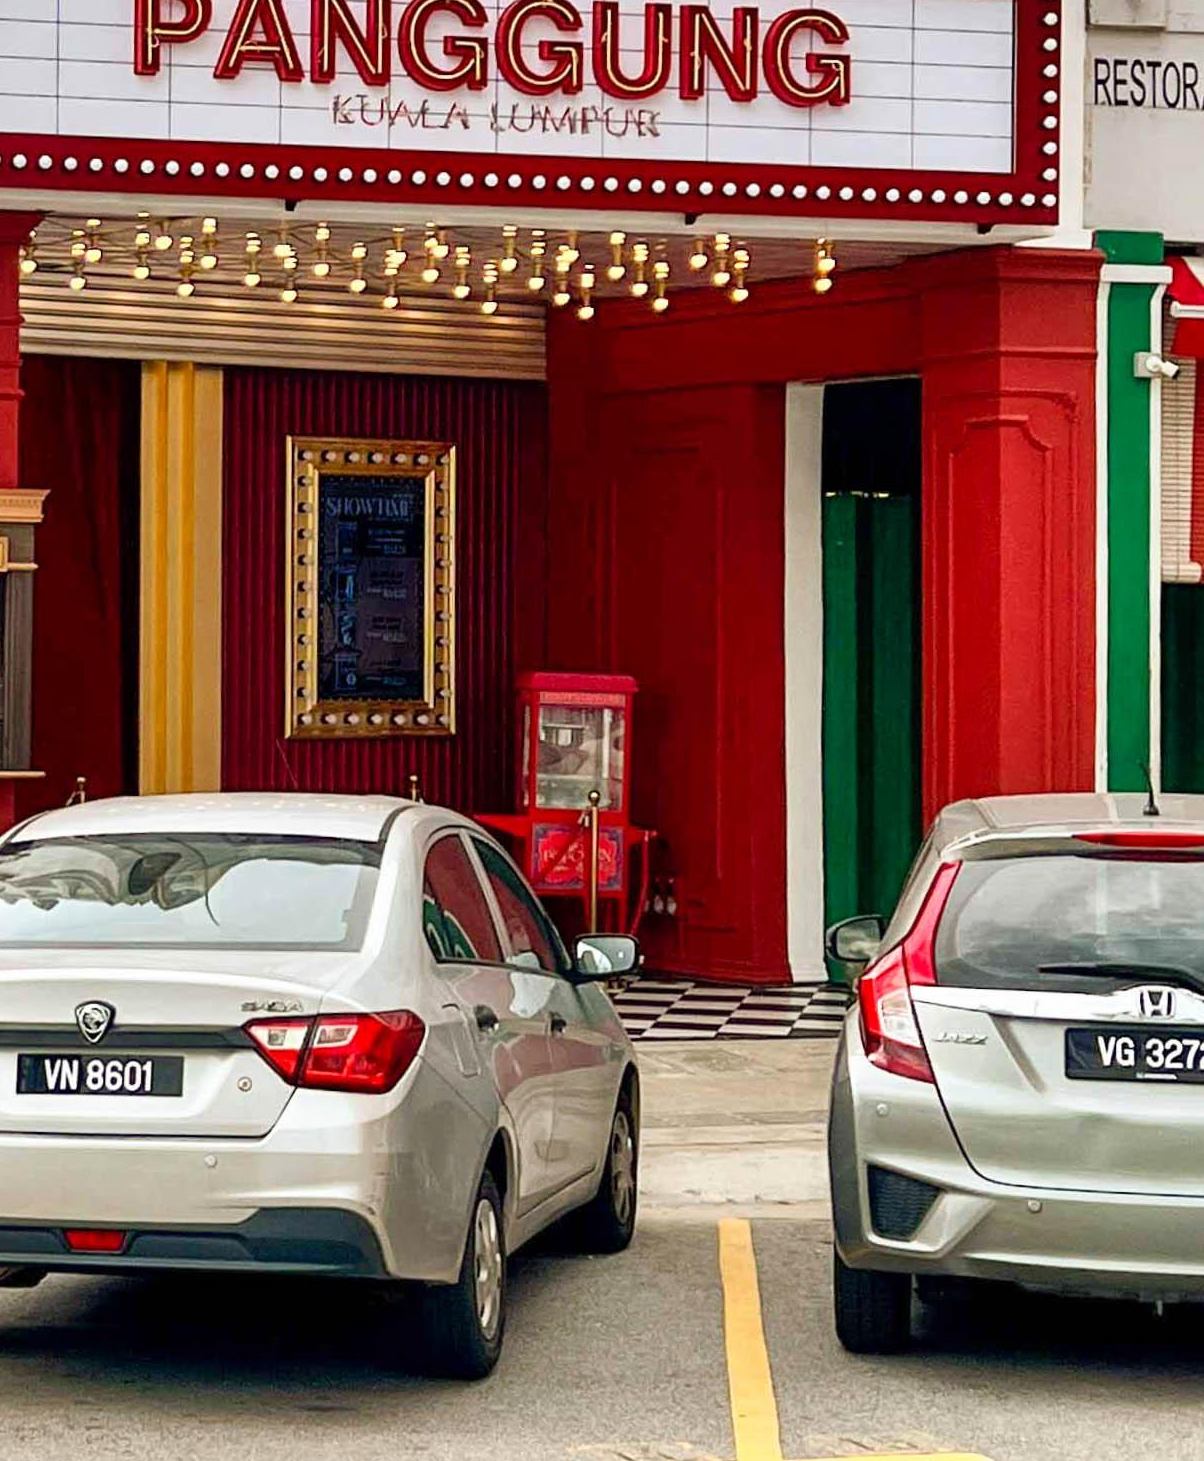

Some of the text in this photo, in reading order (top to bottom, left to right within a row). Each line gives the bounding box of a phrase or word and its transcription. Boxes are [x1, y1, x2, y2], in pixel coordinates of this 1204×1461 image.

[1094, 57, 1204, 112] RESTOR
[333, 93, 661, 138] KUALA LUMPUR
[1097, 1036, 1204, 1070] VG 327
[44, 1058, 153, 1092] VN 8601
